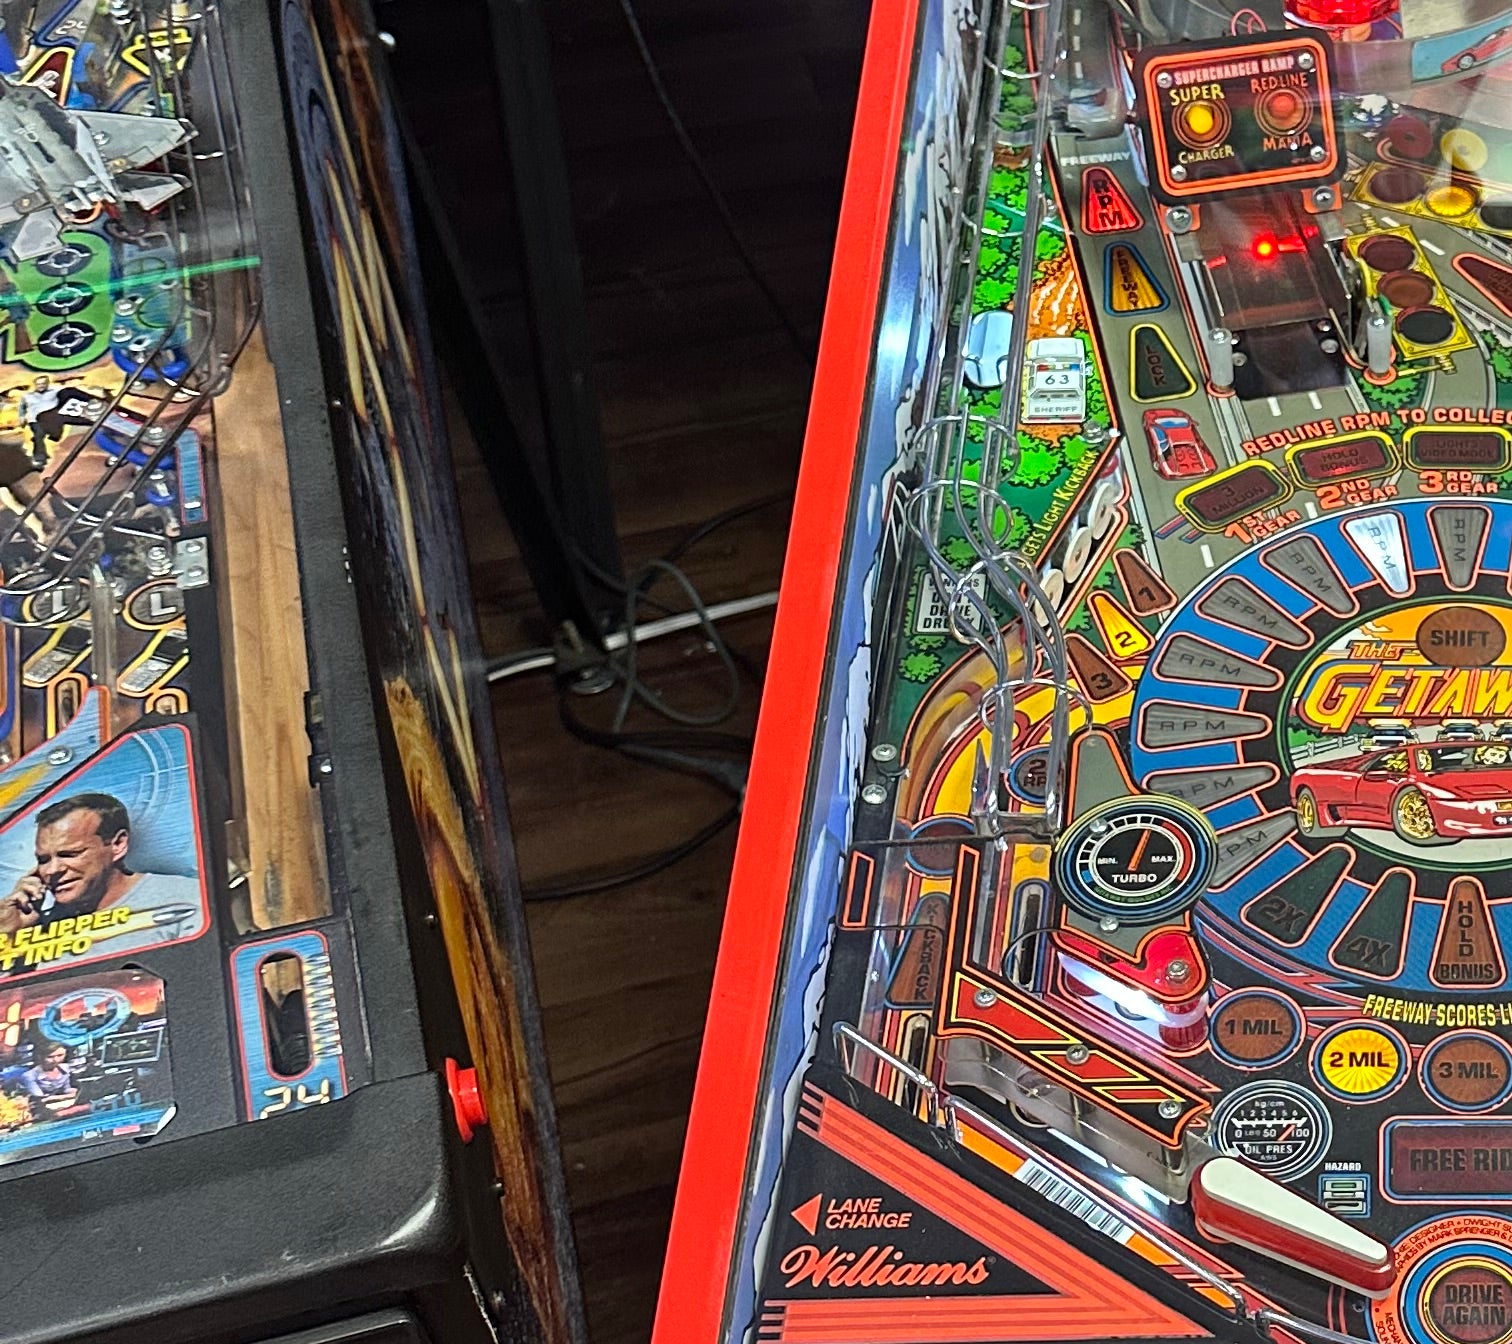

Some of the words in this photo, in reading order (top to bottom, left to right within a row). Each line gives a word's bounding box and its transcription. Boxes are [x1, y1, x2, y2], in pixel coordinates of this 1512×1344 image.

[1173, 60, 1260, 86] SUPERCHARGER
[1261, 55, 1295, 74] RAMP
[1169, 83, 1225, 106] SUPER
[1263, 132, 1314, 152] MANIA
[1060, 151, 1131, 167] FREEWAY
[1178, 145, 1235, 165] CHARGER
[1033, 405, 1078, 414] SHERIFF
[1241, 419, 1337, 457] REDLINE
[1339, 410, 1392, 432] RPM
[1397, 408, 1428, 424] TO
[1315, 478, 1372, 511] 2ND
[1346, 484, 1399, 506] GEAR
[1418, 470, 1473, 495] 3RD
[1446, 481, 1499, 495] GEAR
[1021, 528, 1043, 557] GETS
[1040, 492, 1064, 531] LIGHT
[1060, 450, 1099, 500] KICKBACK
[1253, 509, 1301, 540] GEAR
[1367, 526, 1397, 570] RPM
[1454, 518, 1467, 563] RPM
[1291, 551, 1333, 594] RPM
[1222, 594, 1278, 630] RPM
[1430, 629, 1492, 647] SHIFT
[1179, 652, 1241, 678] RPM
[1159, 719, 1226, 731] RPM
[1111, 873, 1157, 884] TURBO
[14, 906, 132, 949] FLIPPER
[1457, 899, 1475, 958] HOLD
[30, 936, 93, 967] INFO
[1439, 962, 1496, 981] BONUS
[1362, 993, 1434, 1026] FREEWAY
[1436, 1003, 1496, 1028] SCORES
[1224, 1018, 1236, 1035] 1
[1242, 1018, 1284, 1036] MIL
[1329, 1051, 1345, 1068] 2
[1348, 1051, 1391, 1069] MIL
[1439, 1061, 1453, 1079] 3
[1458, 1062, 1499, 1080] MIL
[260, 1079, 332, 1120] 24
[1324, 1162, 1362, 1171] HAZARD
[1409, 1148, 1467, 1172] FREE
[826, 1197, 882, 1215] LANE
[825, 1212, 912, 1230] CHANGE
[779, 1243, 990, 1291] Williams
[1445, 1283, 1504, 1304] DRIVE
[1442, 1306, 1506, 1327] AGAIN
